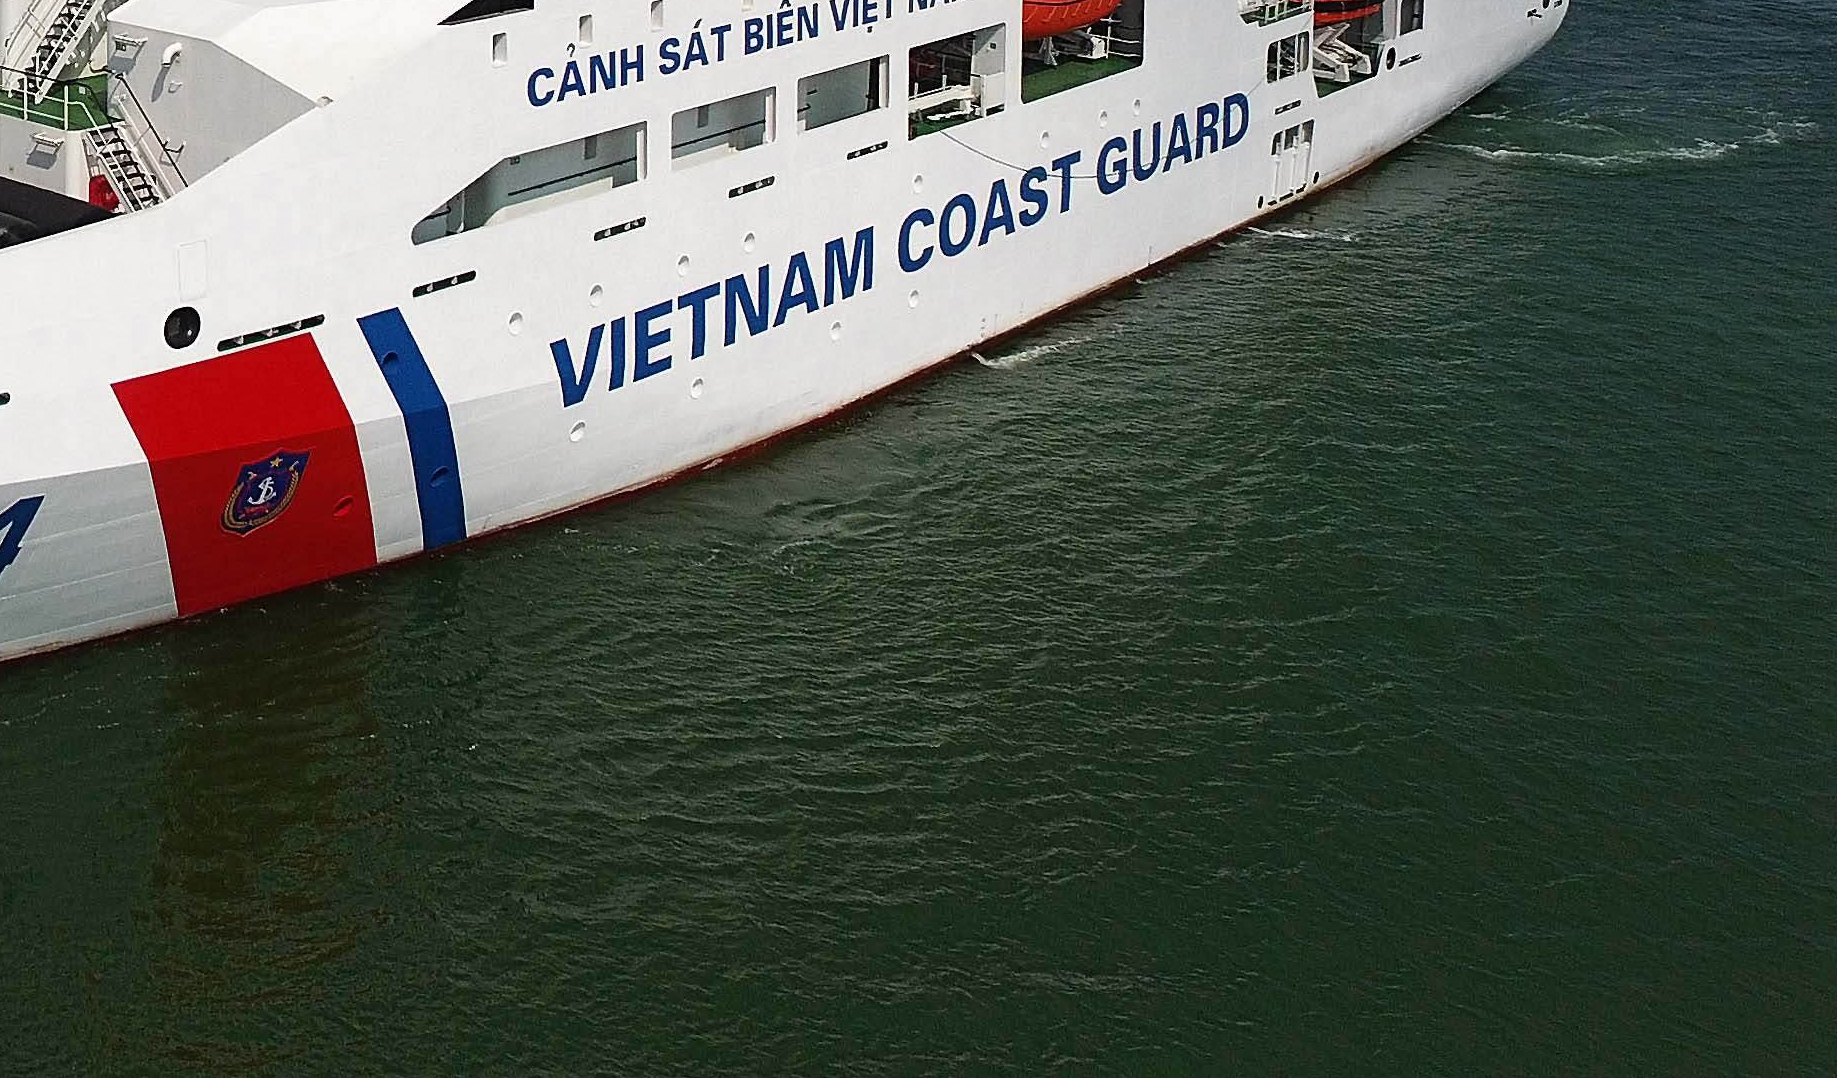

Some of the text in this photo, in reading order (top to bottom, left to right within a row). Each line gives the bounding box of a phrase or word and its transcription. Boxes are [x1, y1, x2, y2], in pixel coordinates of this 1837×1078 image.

[527, 42, 644, 107] CẢNH
[659, 18, 732, 76] SÁT
[550, 92, 1251, 408] VIETNAM COAST GUARD
